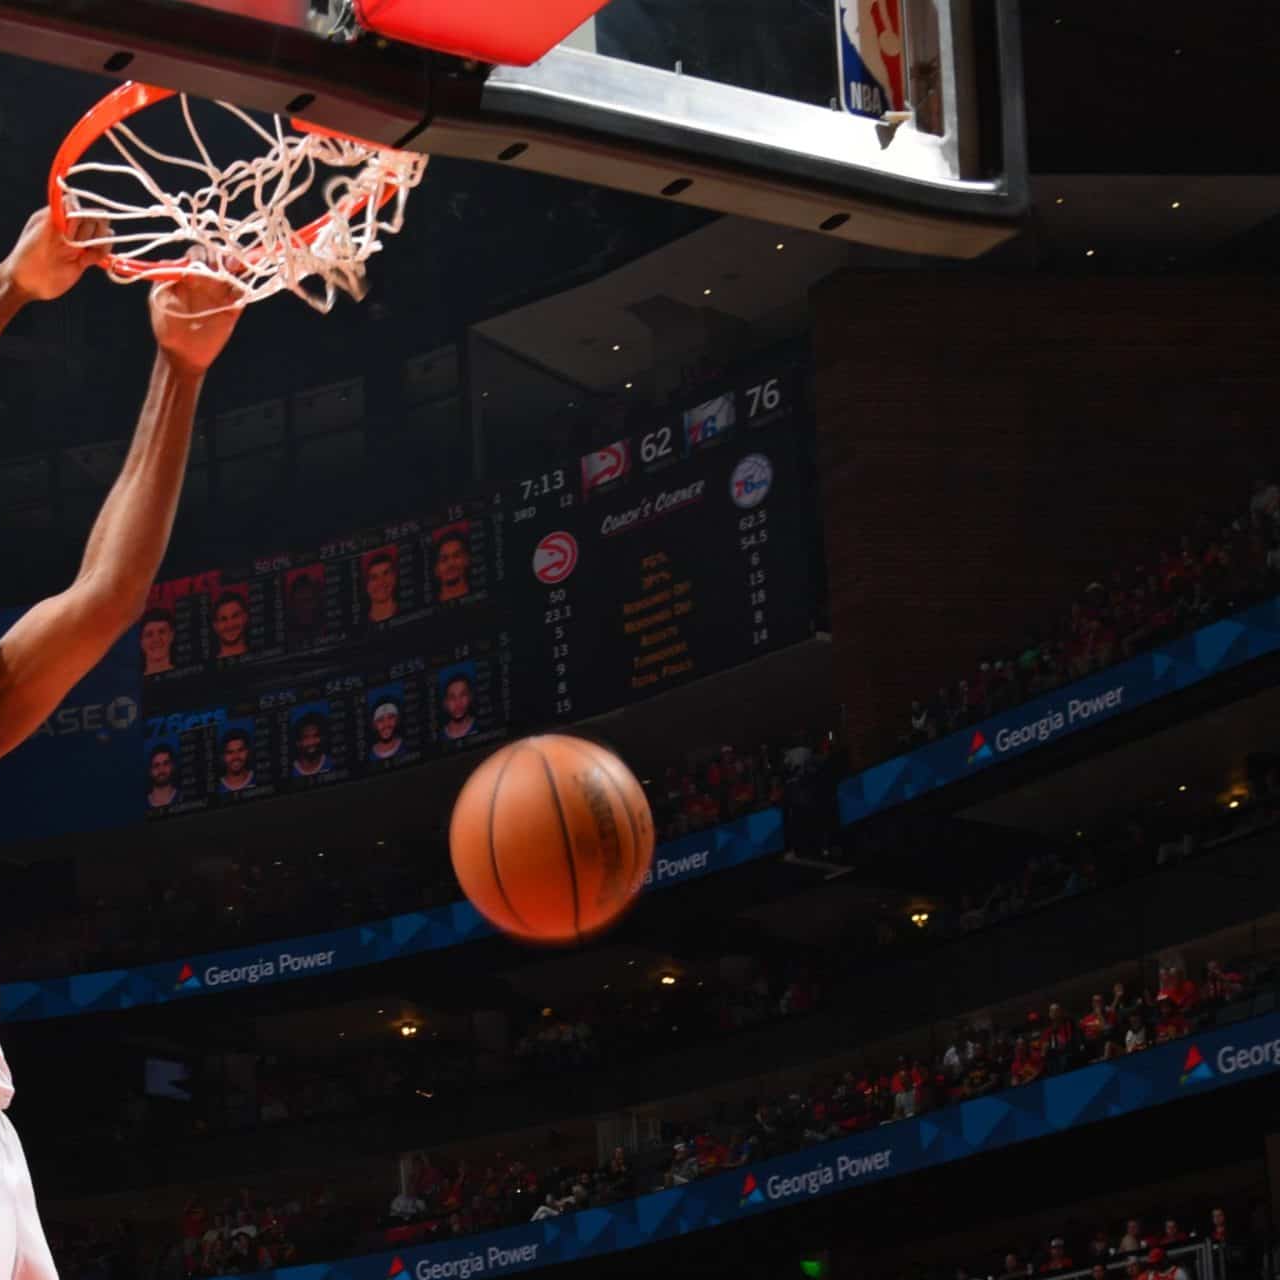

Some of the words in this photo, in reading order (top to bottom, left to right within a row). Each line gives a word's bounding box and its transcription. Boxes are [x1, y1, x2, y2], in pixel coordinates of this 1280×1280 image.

[850, 81, 883, 114] NBA
[746, 378, 781, 417] 76
[641, 426, 672, 463] 62
[520, 469, 565, 500] 7:13
[995, 709, 1065, 752] Georgia
[1068, 686, 1124, 724] Power
[656, 850, 709, 881] Power
[204, 958, 274, 986] Georgia
[279, 950, 335, 974] Power
[767, 1162, 834, 1200] Georgia
[836, 1148, 892, 1181] Power
[416, 1250, 485, 1280] Georgia
[487, 1243, 540, 1270] Power
